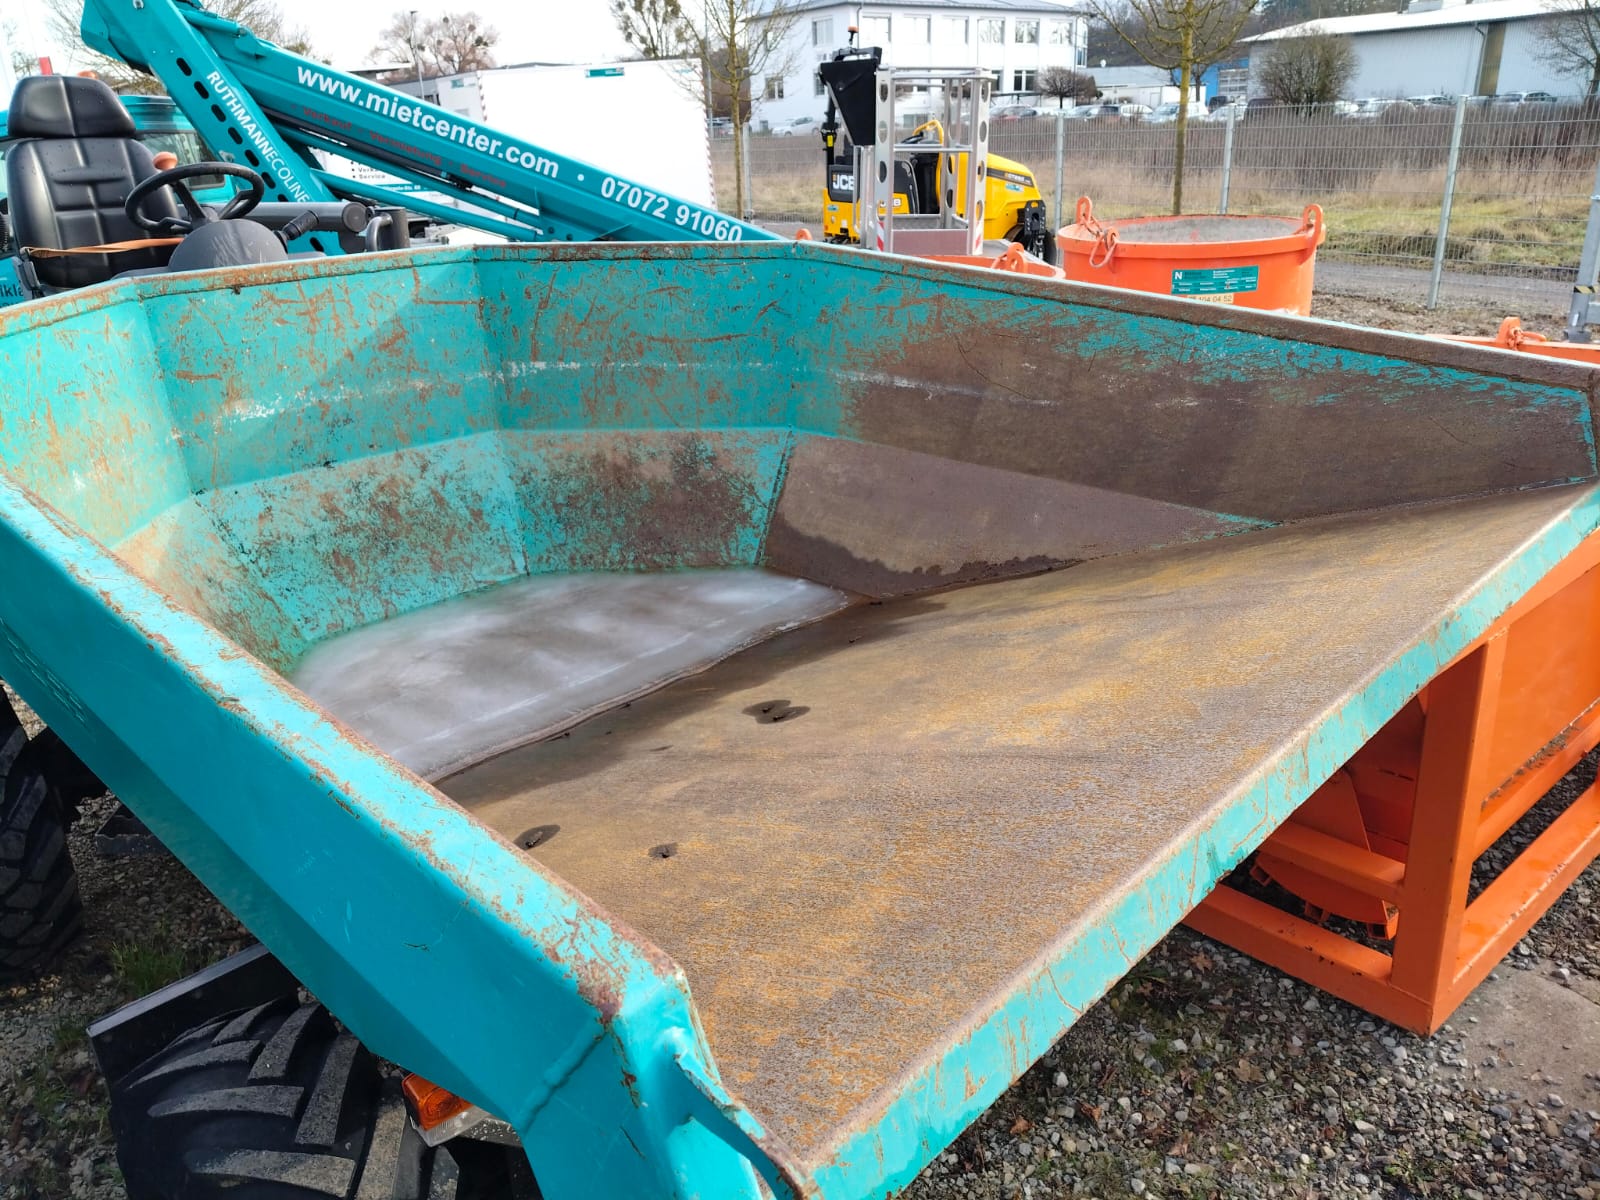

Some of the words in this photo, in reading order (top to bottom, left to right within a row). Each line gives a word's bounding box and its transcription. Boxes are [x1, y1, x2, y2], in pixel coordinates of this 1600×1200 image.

[297, 66, 559, 178] www.mietcenter.com
[601, 176, 670, 219] 07072
[674, 204, 743, 241] 91060
